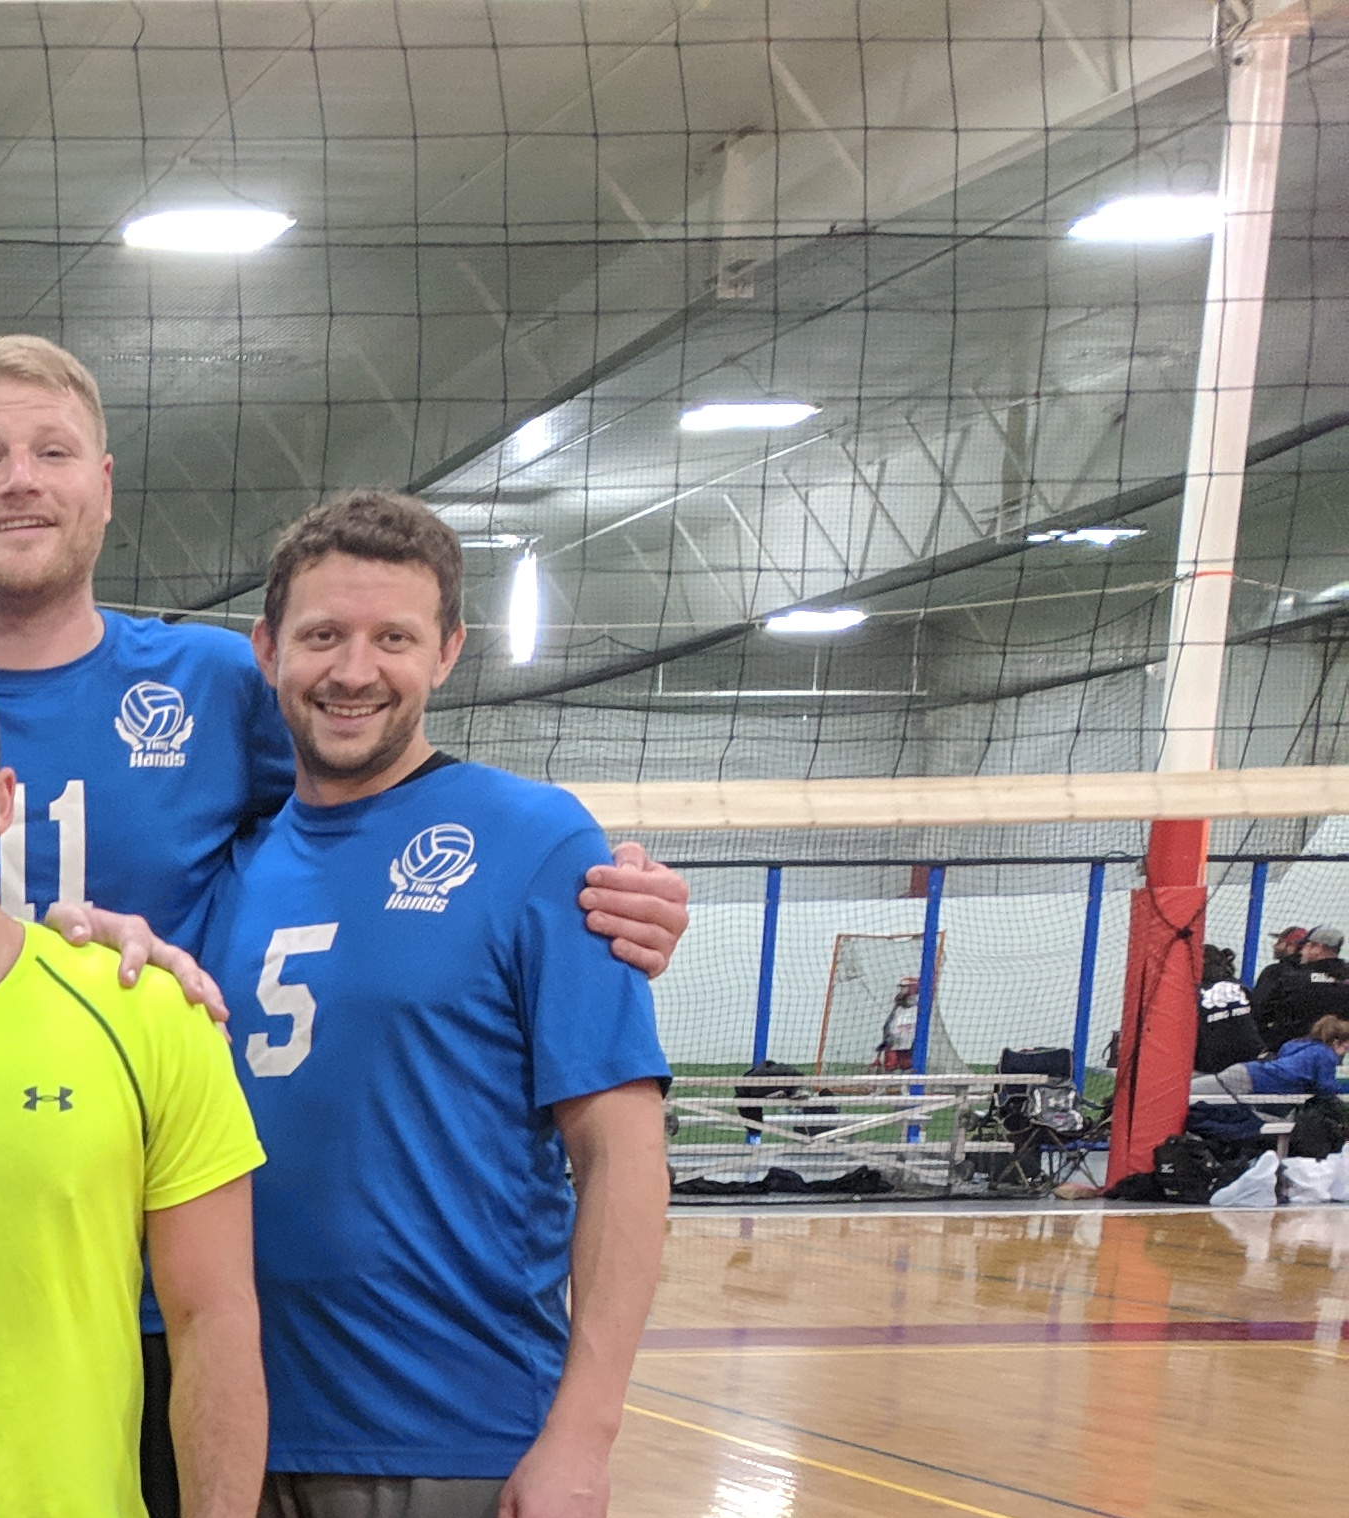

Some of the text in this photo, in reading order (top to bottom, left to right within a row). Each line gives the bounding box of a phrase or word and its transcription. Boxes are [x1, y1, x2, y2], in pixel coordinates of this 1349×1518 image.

[129, 751, 186, 768] Hands
[0, 779, 94, 923] 11
[384, 893, 449, 913] Hands
[245, 922, 339, 1077] 5
